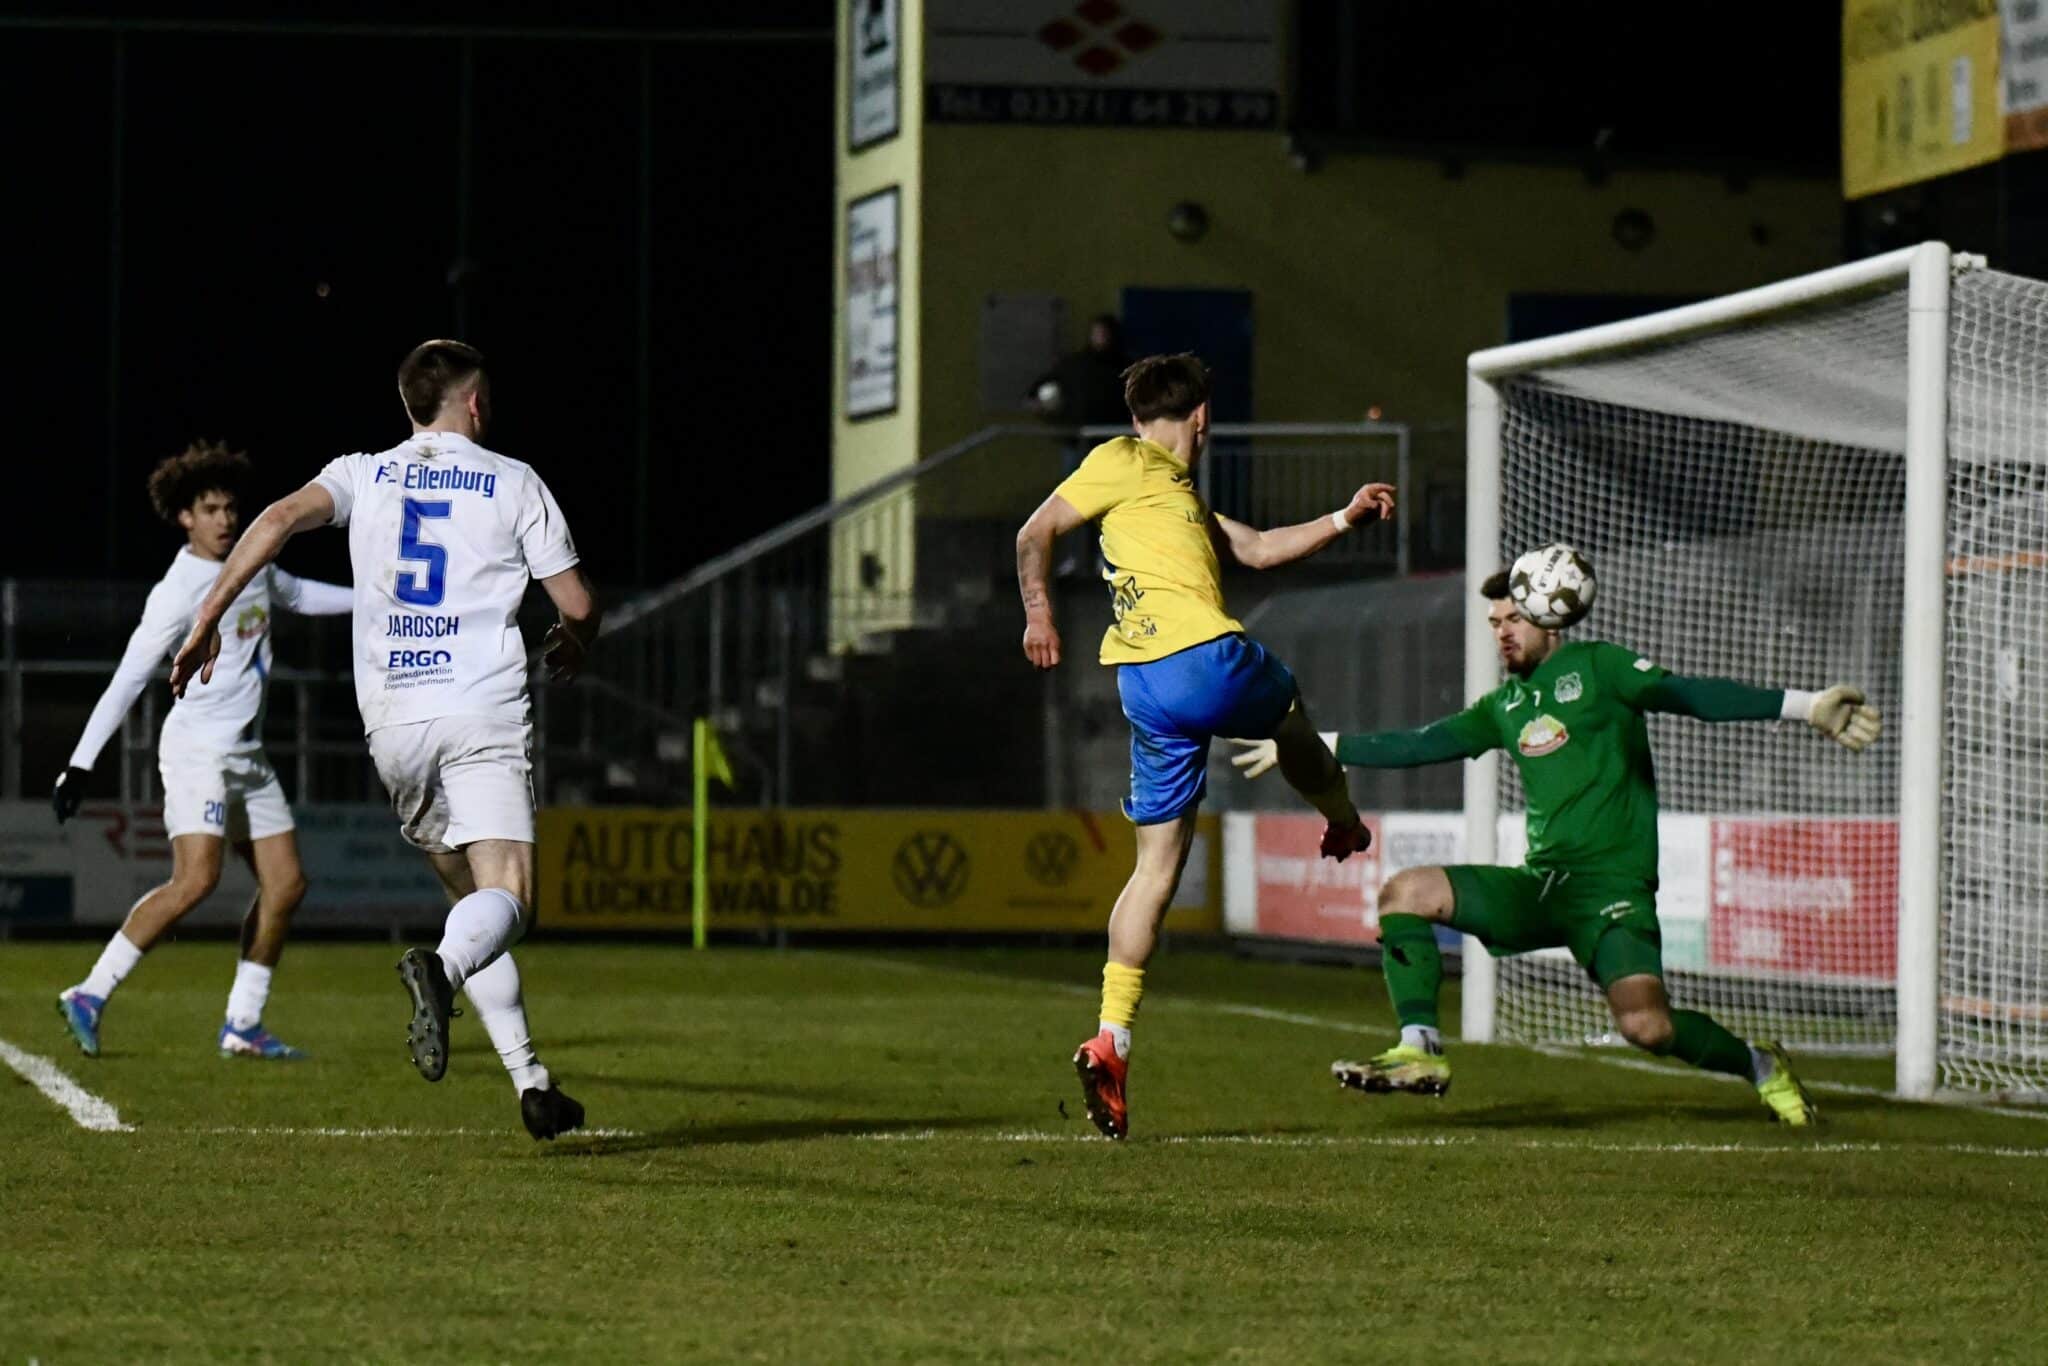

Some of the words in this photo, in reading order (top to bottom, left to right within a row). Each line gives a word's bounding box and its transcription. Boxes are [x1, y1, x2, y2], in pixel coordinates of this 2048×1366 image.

[404, 463, 496, 498] Eilenburg
[394, 495, 453, 607] 5
[386, 615, 459, 638] JAROSCH
[388, 650, 452, 669] ERGO
[203, 800, 225, 827] 20
[563, 822, 842, 876] AUTOHAUS
[561, 878, 840, 917] LUCKEWALDE
